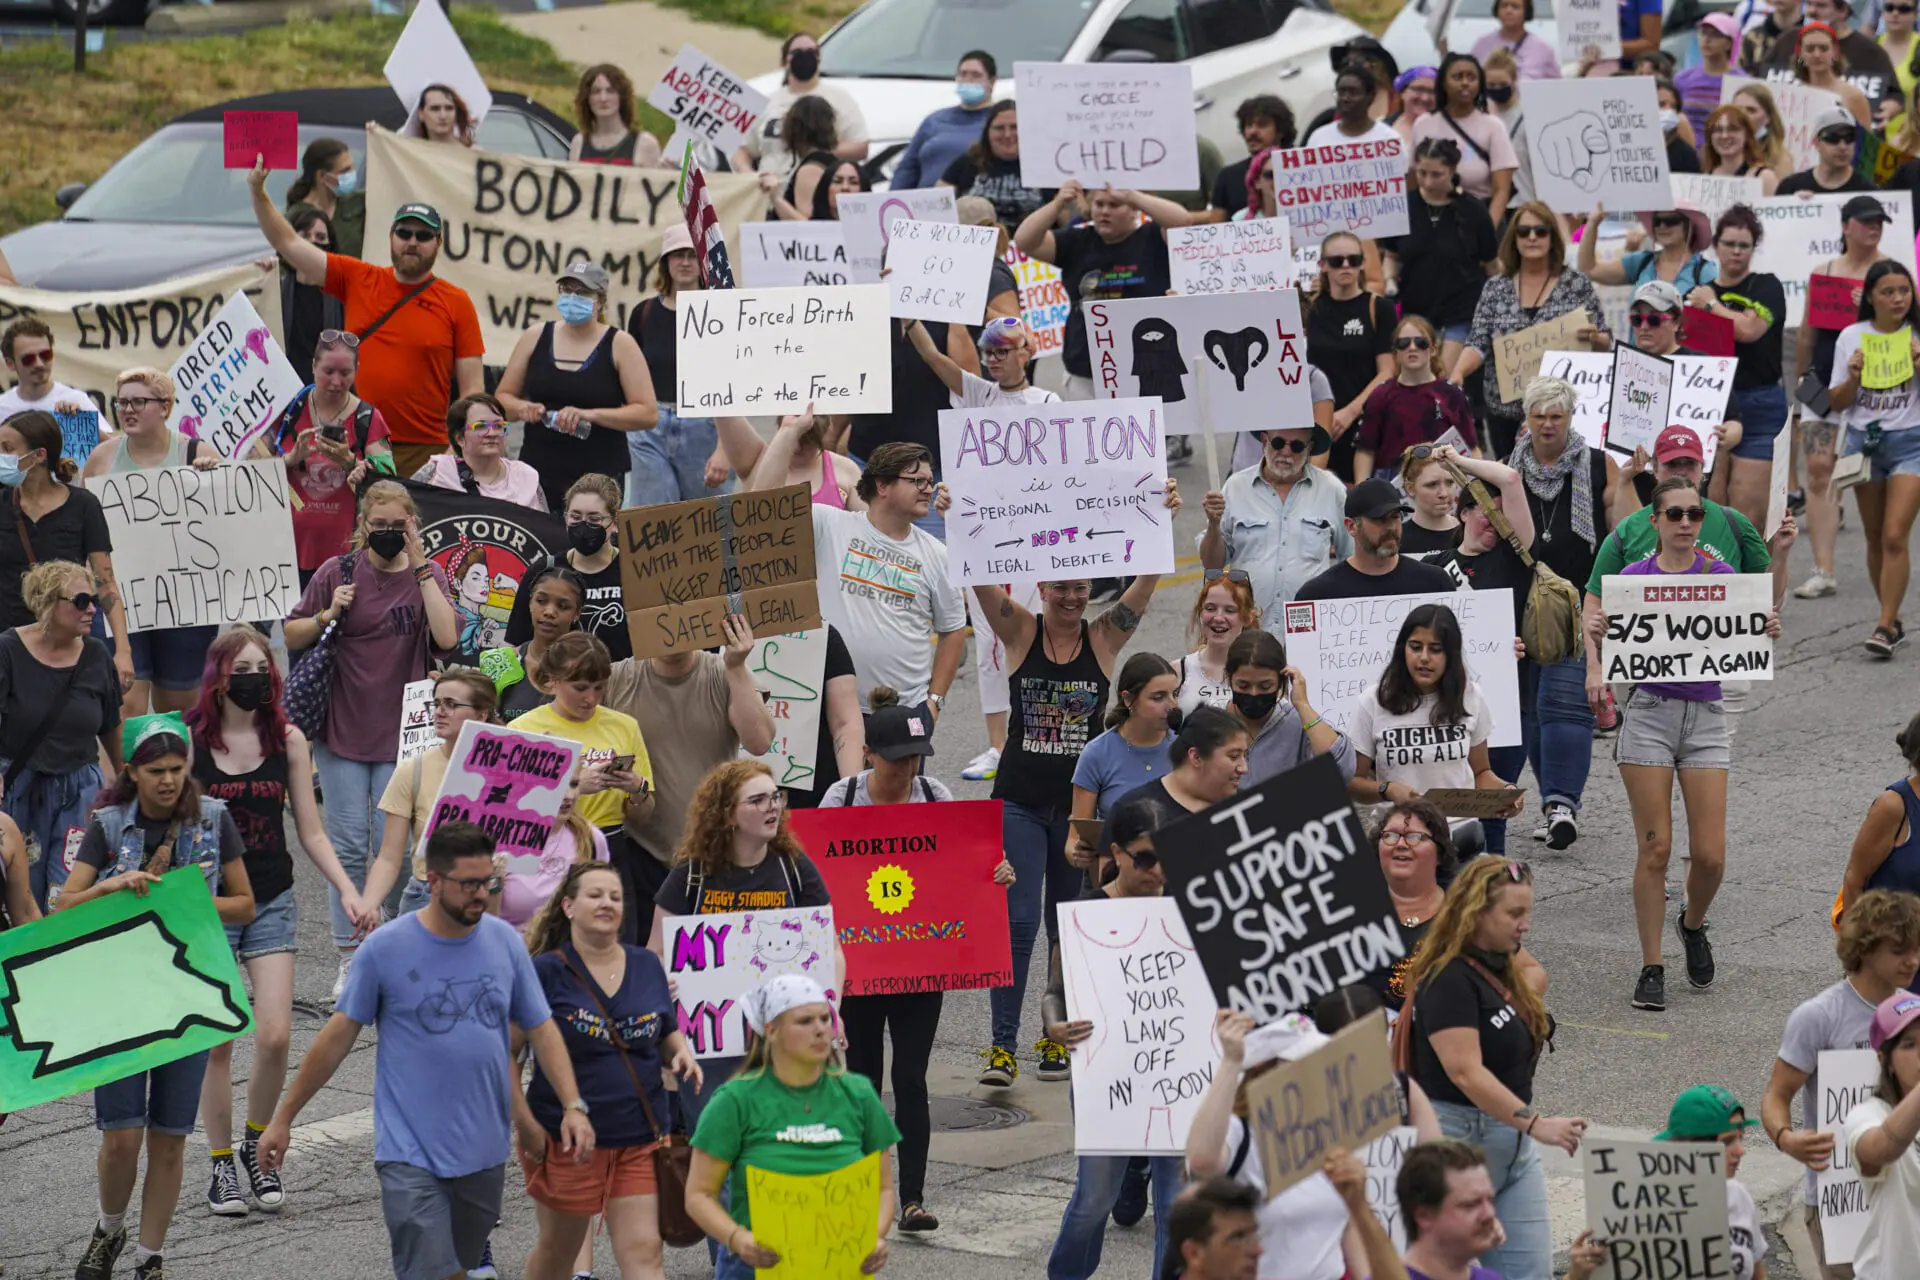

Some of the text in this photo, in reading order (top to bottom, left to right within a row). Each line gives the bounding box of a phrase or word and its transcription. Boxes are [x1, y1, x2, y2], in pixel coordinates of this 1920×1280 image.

[697, 63, 743, 97] KEEP
[662, 66, 757, 134] ABORTION
[1080, 92, 1141, 105] CHOICE
[669, 96, 726, 140] SAFE
[1607, 113, 1647, 130] CHOICE
[1618, 131, 1633, 145] OR
[1055, 138, 1167, 175] CHILD
[1281, 138, 1401, 169] HOOSIERS
[1611, 147, 1656, 164] YOU'RE
[1374, 159, 1400, 178] THE
[1611, 165, 1659, 185] FIRED!
[475, 159, 676, 226] BODILY
[1278, 176, 1406, 207] GOVERNMENT
[1296, 215, 1373, 238] TO DO
[1755, 204, 1824, 220] PROTECT
[893, 220, 922, 240] WE
[1182, 221, 1274, 245] STOP MAKING
[443, 222, 660, 292] UTONMY
[758, 232, 768, 261] I
[780, 241, 827, 263] WILL
[1173, 237, 1283, 261] MEDICAL CHOICES
[803, 271, 848, 286] AND
[923, 255, 954, 275] GO
[1200, 257, 1247, 276] FOR US
[898, 285, 966, 309] BACK
[1026, 279, 1068, 309] POOR
[1186, 272, 1278, 295] BASED ON YOUR
[488, 294, 553, 328] WE
[682, 297, 855, 339] No Forced Birth
[1031, 305, 1069, 330] BLAC
[175, 320, 235, 404] ORCED
[735, 337, 805, 360] in the
[1275, 319, 1303, 386] LAW
[191, 347, 247, 418] BIRTH
[1681, 362, 1725, 392] You
[218, 390, 241, 418] is a
[681, 380, 734, 409] Land
[745, 386, 763, 402] of
[773, 382, 798, 402] the
[211, 377, 276, 459] CRIME
[1675, 401, 1721, 421] can
[956, 409, 1156, 469] ABORTION
[101, 463, 287, 525] ABORTION
[1021, 476, 1088, 493] is a
[979, 490, 1147, 521] PERSONAL DECISION
[453, 520, 527, 553] YOUR
[624, 491, 812, 554] LEAVE THE CHOICE
[1031, 526, 1079, 548] NOT
[160, 520, 220, 573] IS
[632, 527, 796, 580] WITH THE PEOPLE
[847, 537, 923, 572] STRONGER
[963, 551, 1114, 577] A LEGAL DEBATE
[659, 554, 798, 611] KEEP ABORTION
[839, 578, 914, 610] TOGETHER
[656, 598, 805, 648] SAFE LEGAL
[1319, 597, 1421, 627] PROTECT
[1318, 629, 1369, 651] LIFE
[1607, 612, 1768, 643] 5/5 WOULD
[1319, 650, 1393, 671] PREGNAN
[1607, 650, 1770, 681] ABORT AGAIN
[1021, 677, 1098, 693] NOT FRAGILE
[1021, 689, 1059, 704] LIKE A
[1321, 678, 1368, 707] KEEP
[1023, 714, 1062, 728] FRAGILE
[1023, 726, 1058, 741] LIKE A
[1383, 724, 1467, 747] RIGHTS
[469, 737, 566, 781] PRO-CHOICE
[1022, 739, 1064, 755] BOMB
[1386, 742, 1467, 766] FOR ALL
[1210, 792, 1278, 858] I
[825, 834, 938, 859] ABORTION
[1186, 805, 1357, 932] SUPPORT
[703, 888, 788, 907] ZIGGY STARDUST
[881, 880, 903, 899] IS
[836, 919, 967, 946] HEALTHCARE
[1232, 871, 1356, 972] SAFE
[670, 921, 733, 974] MY
[1119, 950, 1186, 985] KEEP
[1226, 914, 1406, 1027] ABORTION
[862, 971, 1013, 996] REPRODUCTIVE RIGHTS!!
[1126, 987, 1185, 1016] YOUR
[675, 998, 735, 1055] MY
[1124, 1017, 1185, 1045] LAWS
[1134, 1048, 1178, 1075] OFF
[1109, 1060, 1214, 1110] MY BODY
[1591, 1148, 1722, 1178] I DON'T
[752, 1170, 809, 1211] Keep
[1612, 1181, 1698, 1210] CARE
[1603, 1210, 1688, 1237] WHAT
[1608, 1235, 1733, 1280] BIBLE
